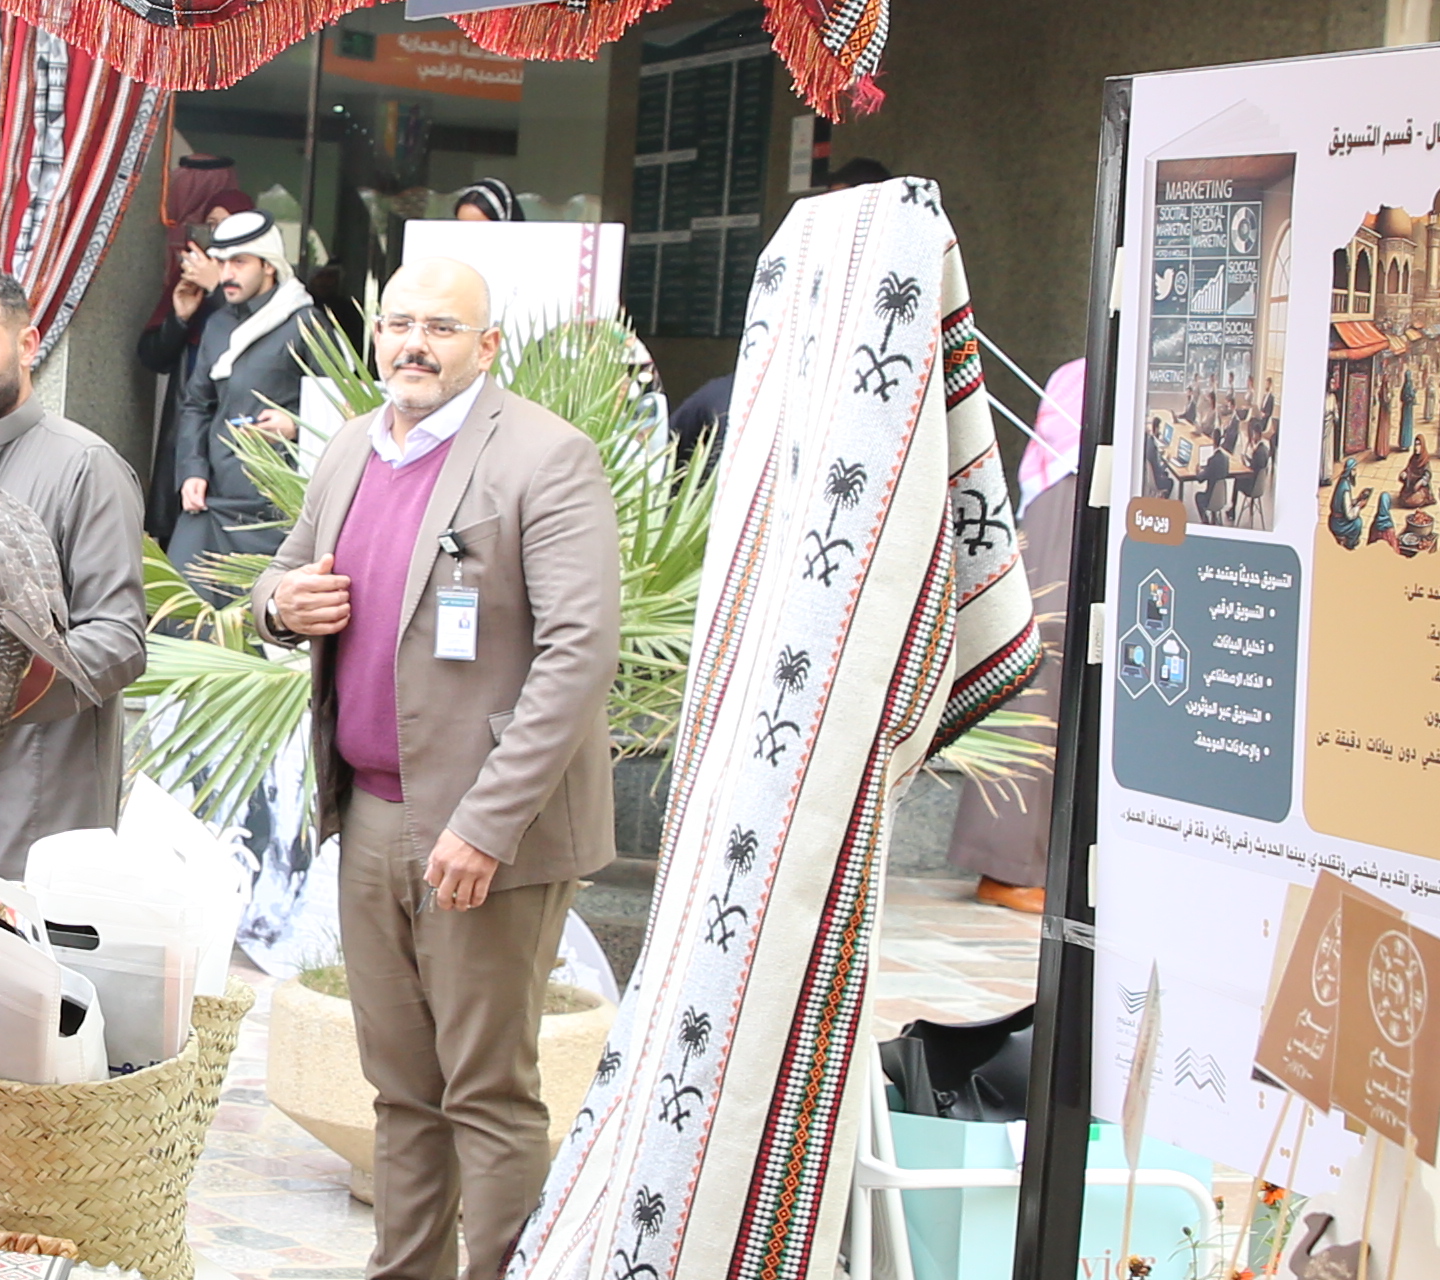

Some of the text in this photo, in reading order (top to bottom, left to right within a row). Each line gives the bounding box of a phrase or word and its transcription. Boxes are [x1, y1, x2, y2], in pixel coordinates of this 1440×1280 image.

[1328, 125, 1381, 156] التسويق
[1382, 118, 1413, 155] قسم
[1165, 179, 1234, 200] MARKETING
[1153, 516, 1170, 533] وين
[1215, 566, 1238, 586] يعتمد
[1260, 571, 1293, 590] التسويق
[1233, 601, 1265, 622] التسويق
[1242, 639, 1265, 657] تحليل
[1231, 704, 1262, 725] التسويق
[1316, 731, 1330, 747] عن
[1335, 728, 1361, 753] دقيقة
[1366, 737, 1393, 761] بيانات
[1398, 746, 1417, 763] دون
[1182, 817, 1193, 842] في
[1194, 820, 1209, 840] دقة
[1211, 824, 1231, 850] وأكثر
[1232, 831, 1253, 855] رقمي
[1254, 836, 1284, 859] الحديث
[1285, 844, 1306, 868] بينما
[1346, 860, 1378, 883] شخصي
[1379, 869, 1410, 889] القديم
